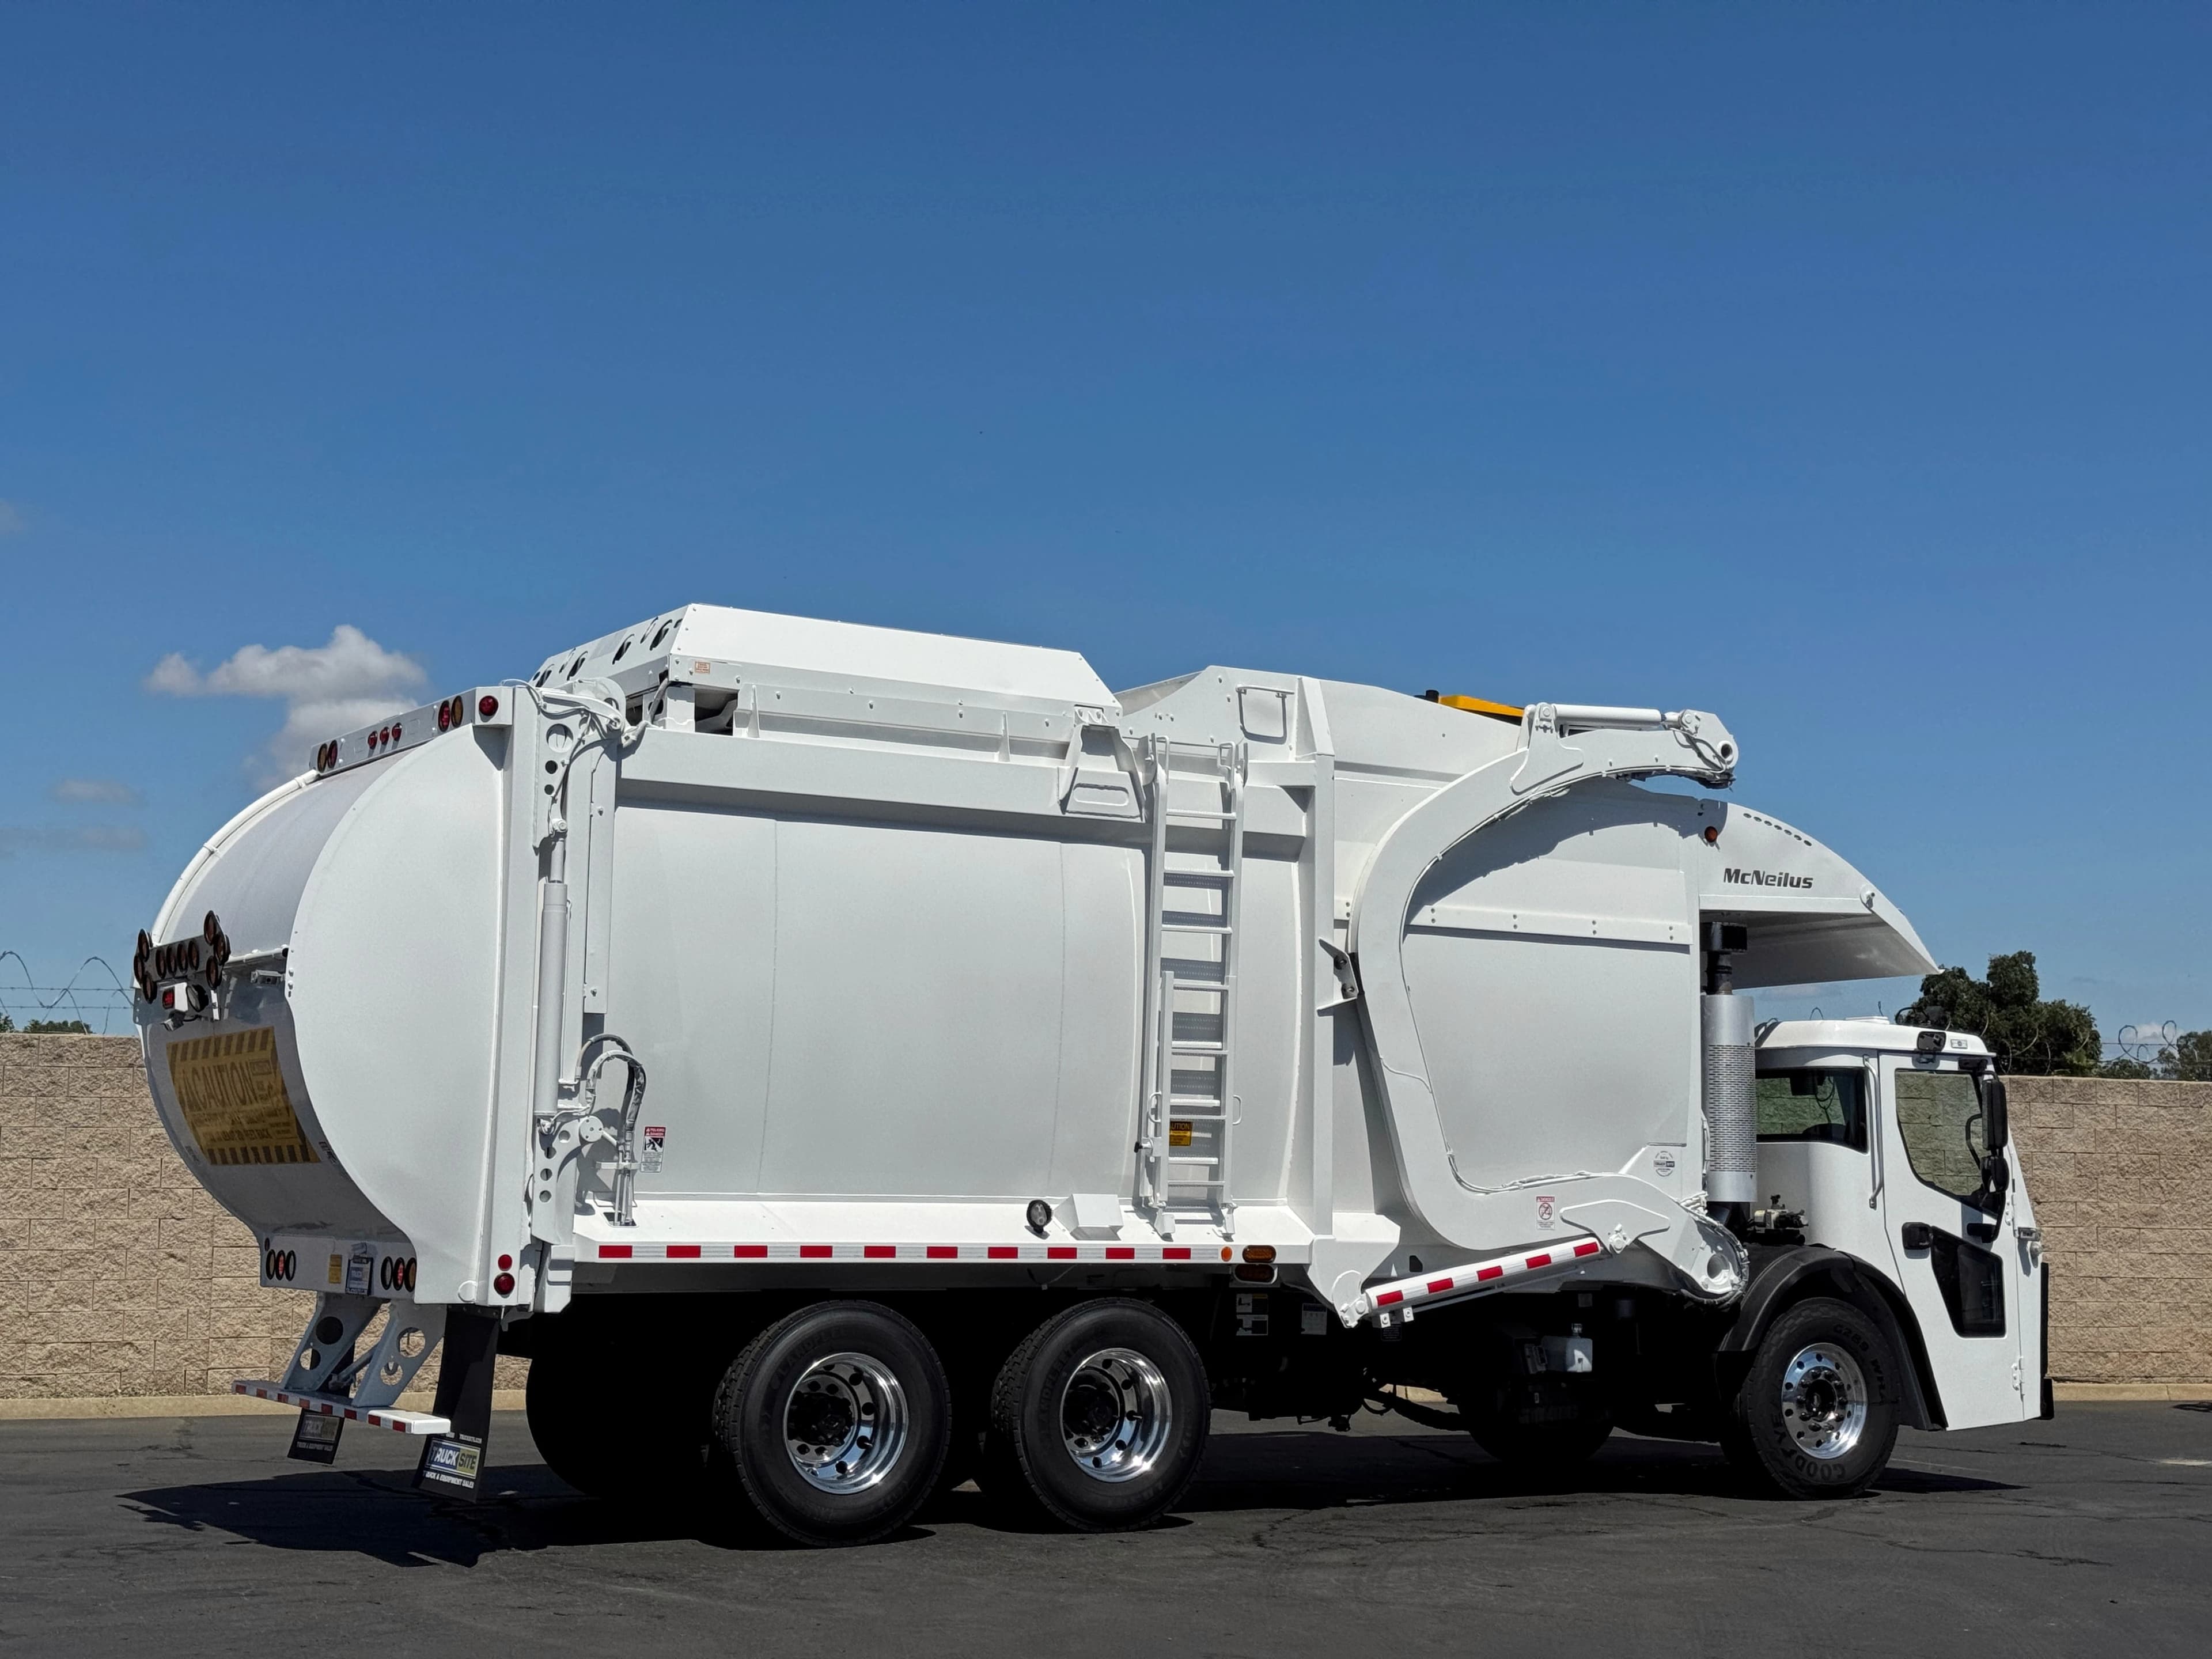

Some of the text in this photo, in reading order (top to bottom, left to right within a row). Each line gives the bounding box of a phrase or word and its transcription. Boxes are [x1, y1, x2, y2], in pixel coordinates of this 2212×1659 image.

[1723, 868, 1813, 889] McNeilus
[192, 1061, 258, 1108] CAUTION
[431, 1446, 477, 1470] TRUCK SITE
